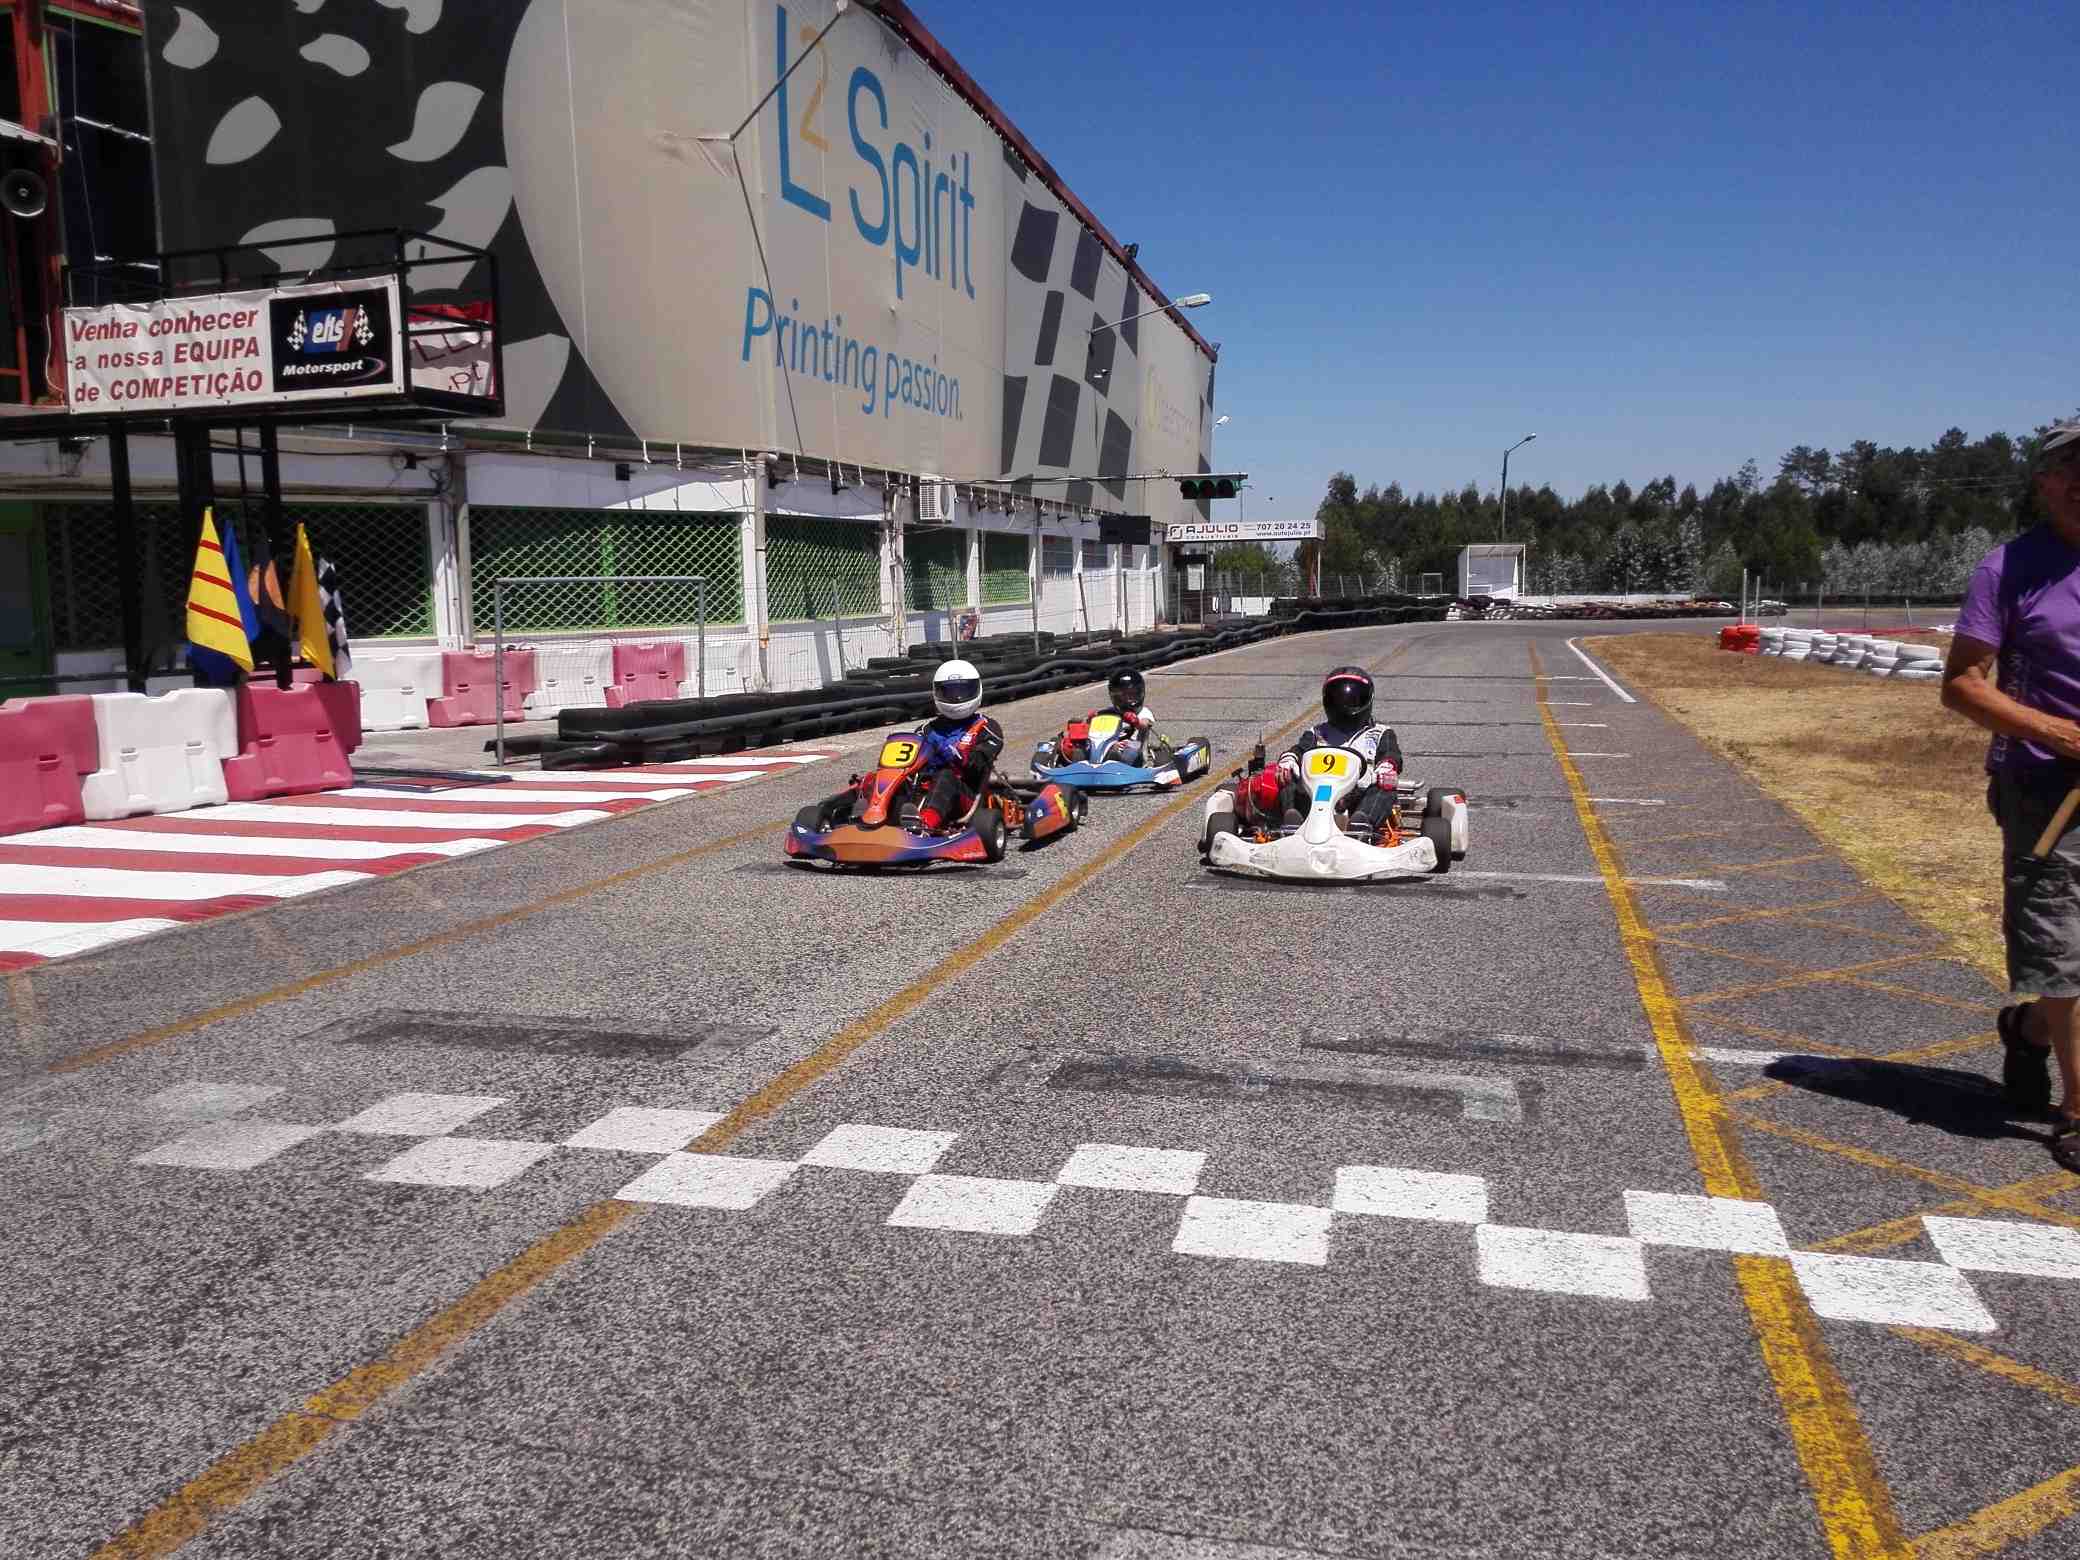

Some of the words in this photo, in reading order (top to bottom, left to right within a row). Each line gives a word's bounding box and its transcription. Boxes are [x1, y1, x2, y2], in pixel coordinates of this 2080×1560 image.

[848, 66, 976, 299] Spirit
[71, 316, 139, 342] Venha
[148, 309, 259, 337] conhecer
[75, 355, 86, 370] a
[98, 350, 163, 369] nossa
[174, 336, 260, 364] EQUIPA
[282, 360, 364, 377] Motorsport
[742, 287, 877, 416] Printing
[886, 354, 963, 421] passion.
[75, 382, 100, 402] de
[110, 367, 263, 400] COMPETIÇÃO
[1256, 522, 1272, 531] 707
[1274, 522, 1285, 530] 20
[1300, 521, 1312, 529] 25
[895, 743, 914, 762] 3
[1320, 753, 1336, 773] 9
